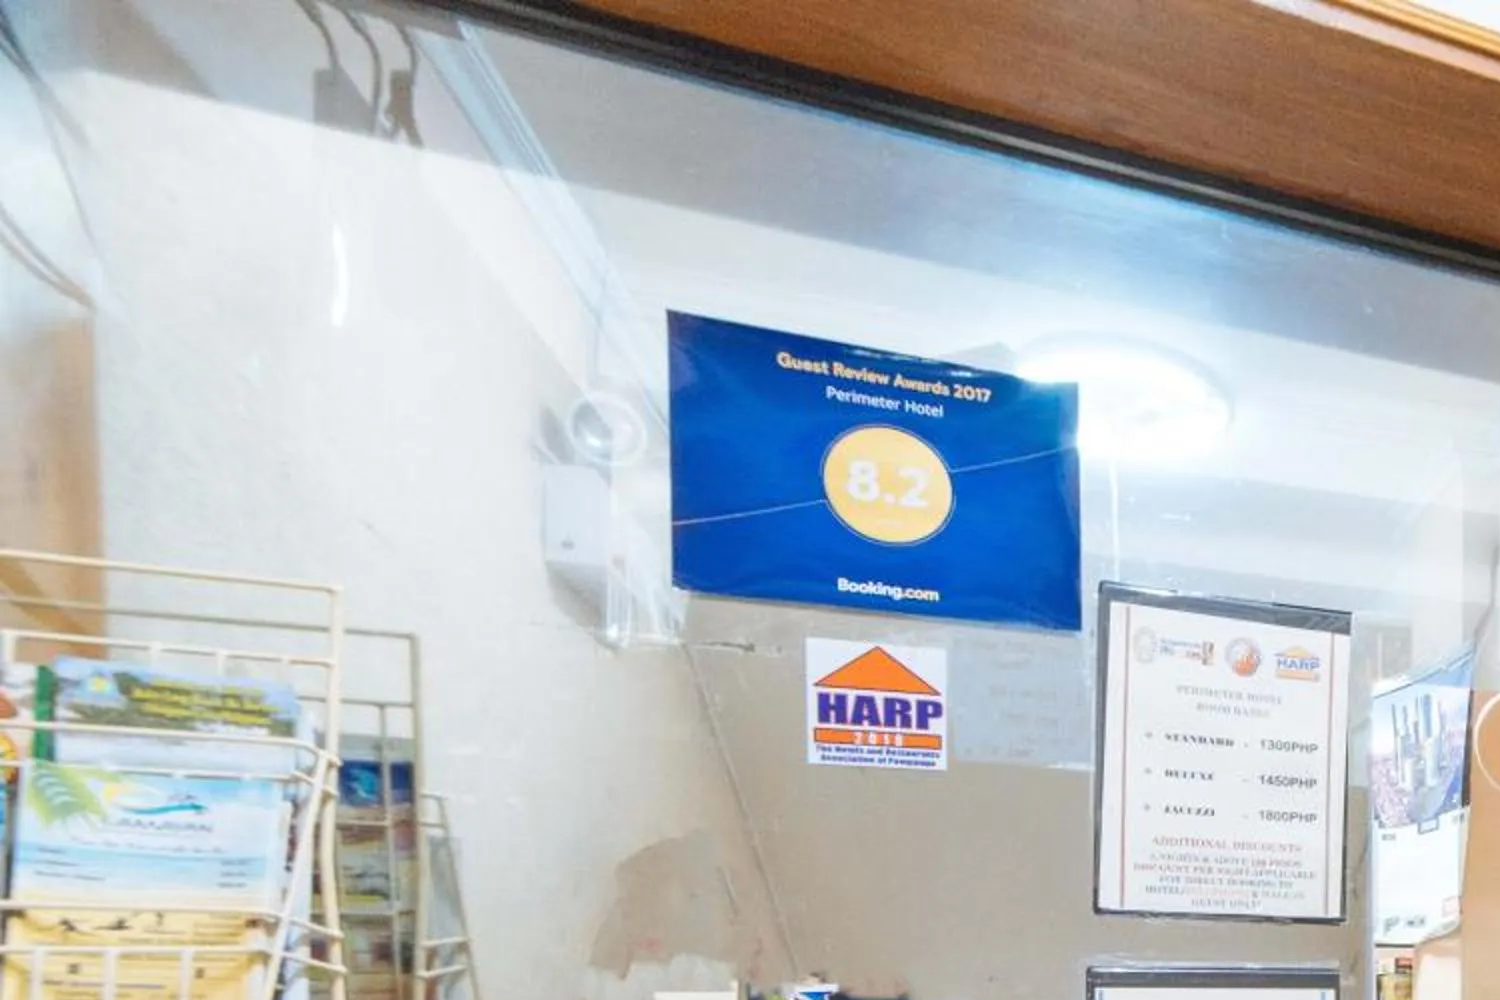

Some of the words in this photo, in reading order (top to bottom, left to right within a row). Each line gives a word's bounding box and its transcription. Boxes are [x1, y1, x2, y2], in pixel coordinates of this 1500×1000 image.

[776, 351, 829, 376] Guest
[832, 361, 890, 385] Review
[893, 373, 949, 396] Awards
[952, 383, 992, 403] 2017
[826, 385, 901, 410] Perimeter
[905, 399, 944, 418] Hotel
[846, 460, 930, 508] 8.2
[837, 577, 940, 602] Booking.com
[817, 691, 943, 730] HARP
[1260, 738, 1319, 754] 1300PHP
[1259, 774, 1317, 789] 1450PHP
[1258, 809, 1317, 824] 1800PHP
